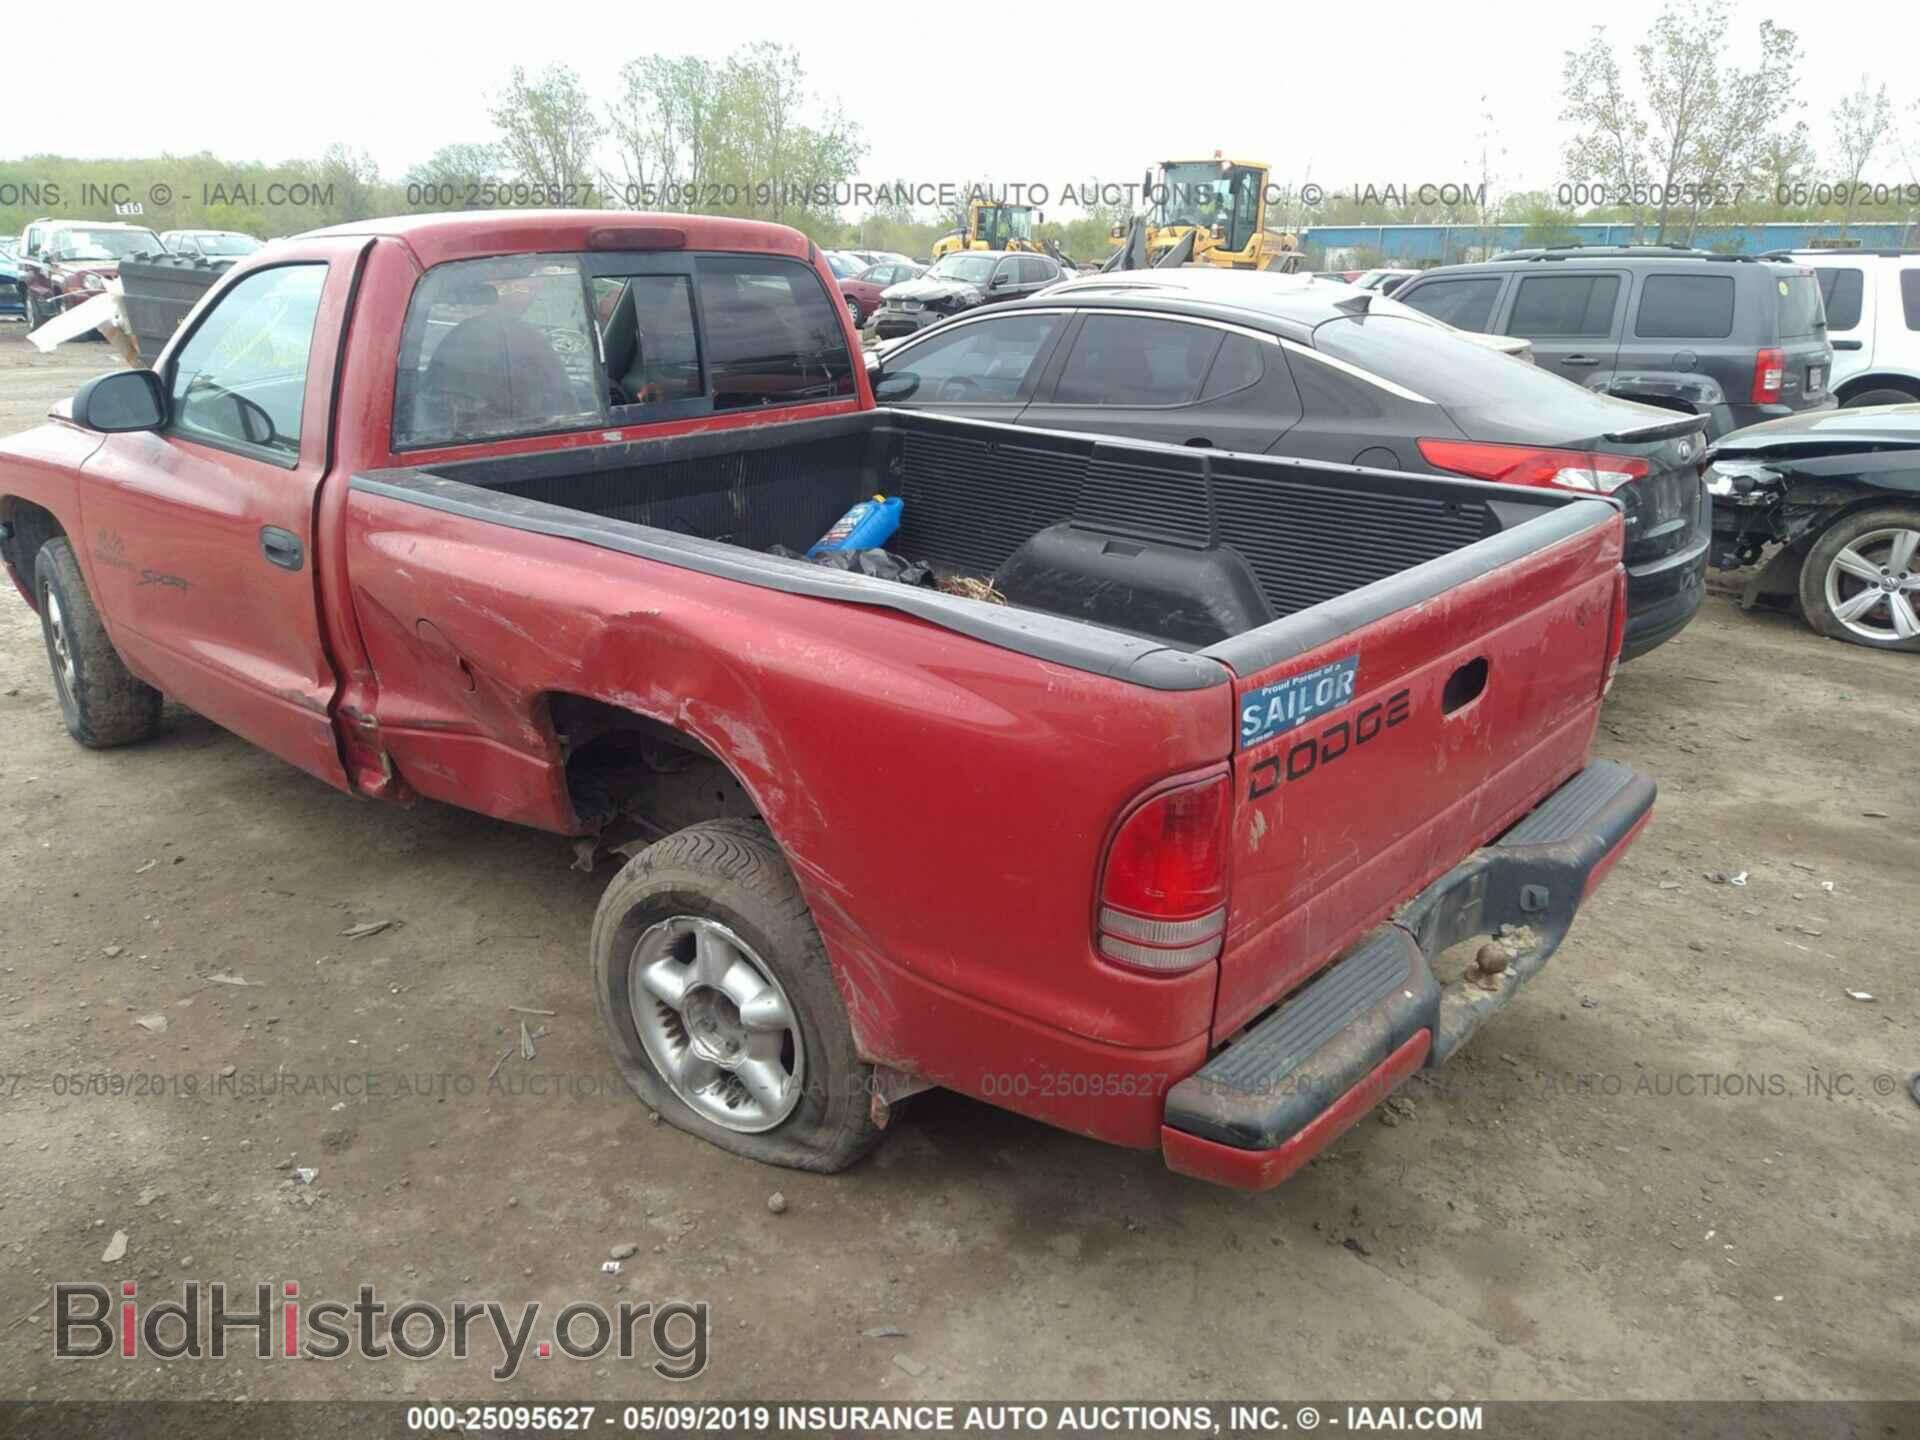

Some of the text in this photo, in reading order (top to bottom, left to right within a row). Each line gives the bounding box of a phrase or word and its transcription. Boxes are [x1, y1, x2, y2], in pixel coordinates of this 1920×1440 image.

[1241, 669, 1356, 737] SAILOR
[1261, 679, 1291, 697] Proud
[1247, 688, 1410, 802] DODGE
